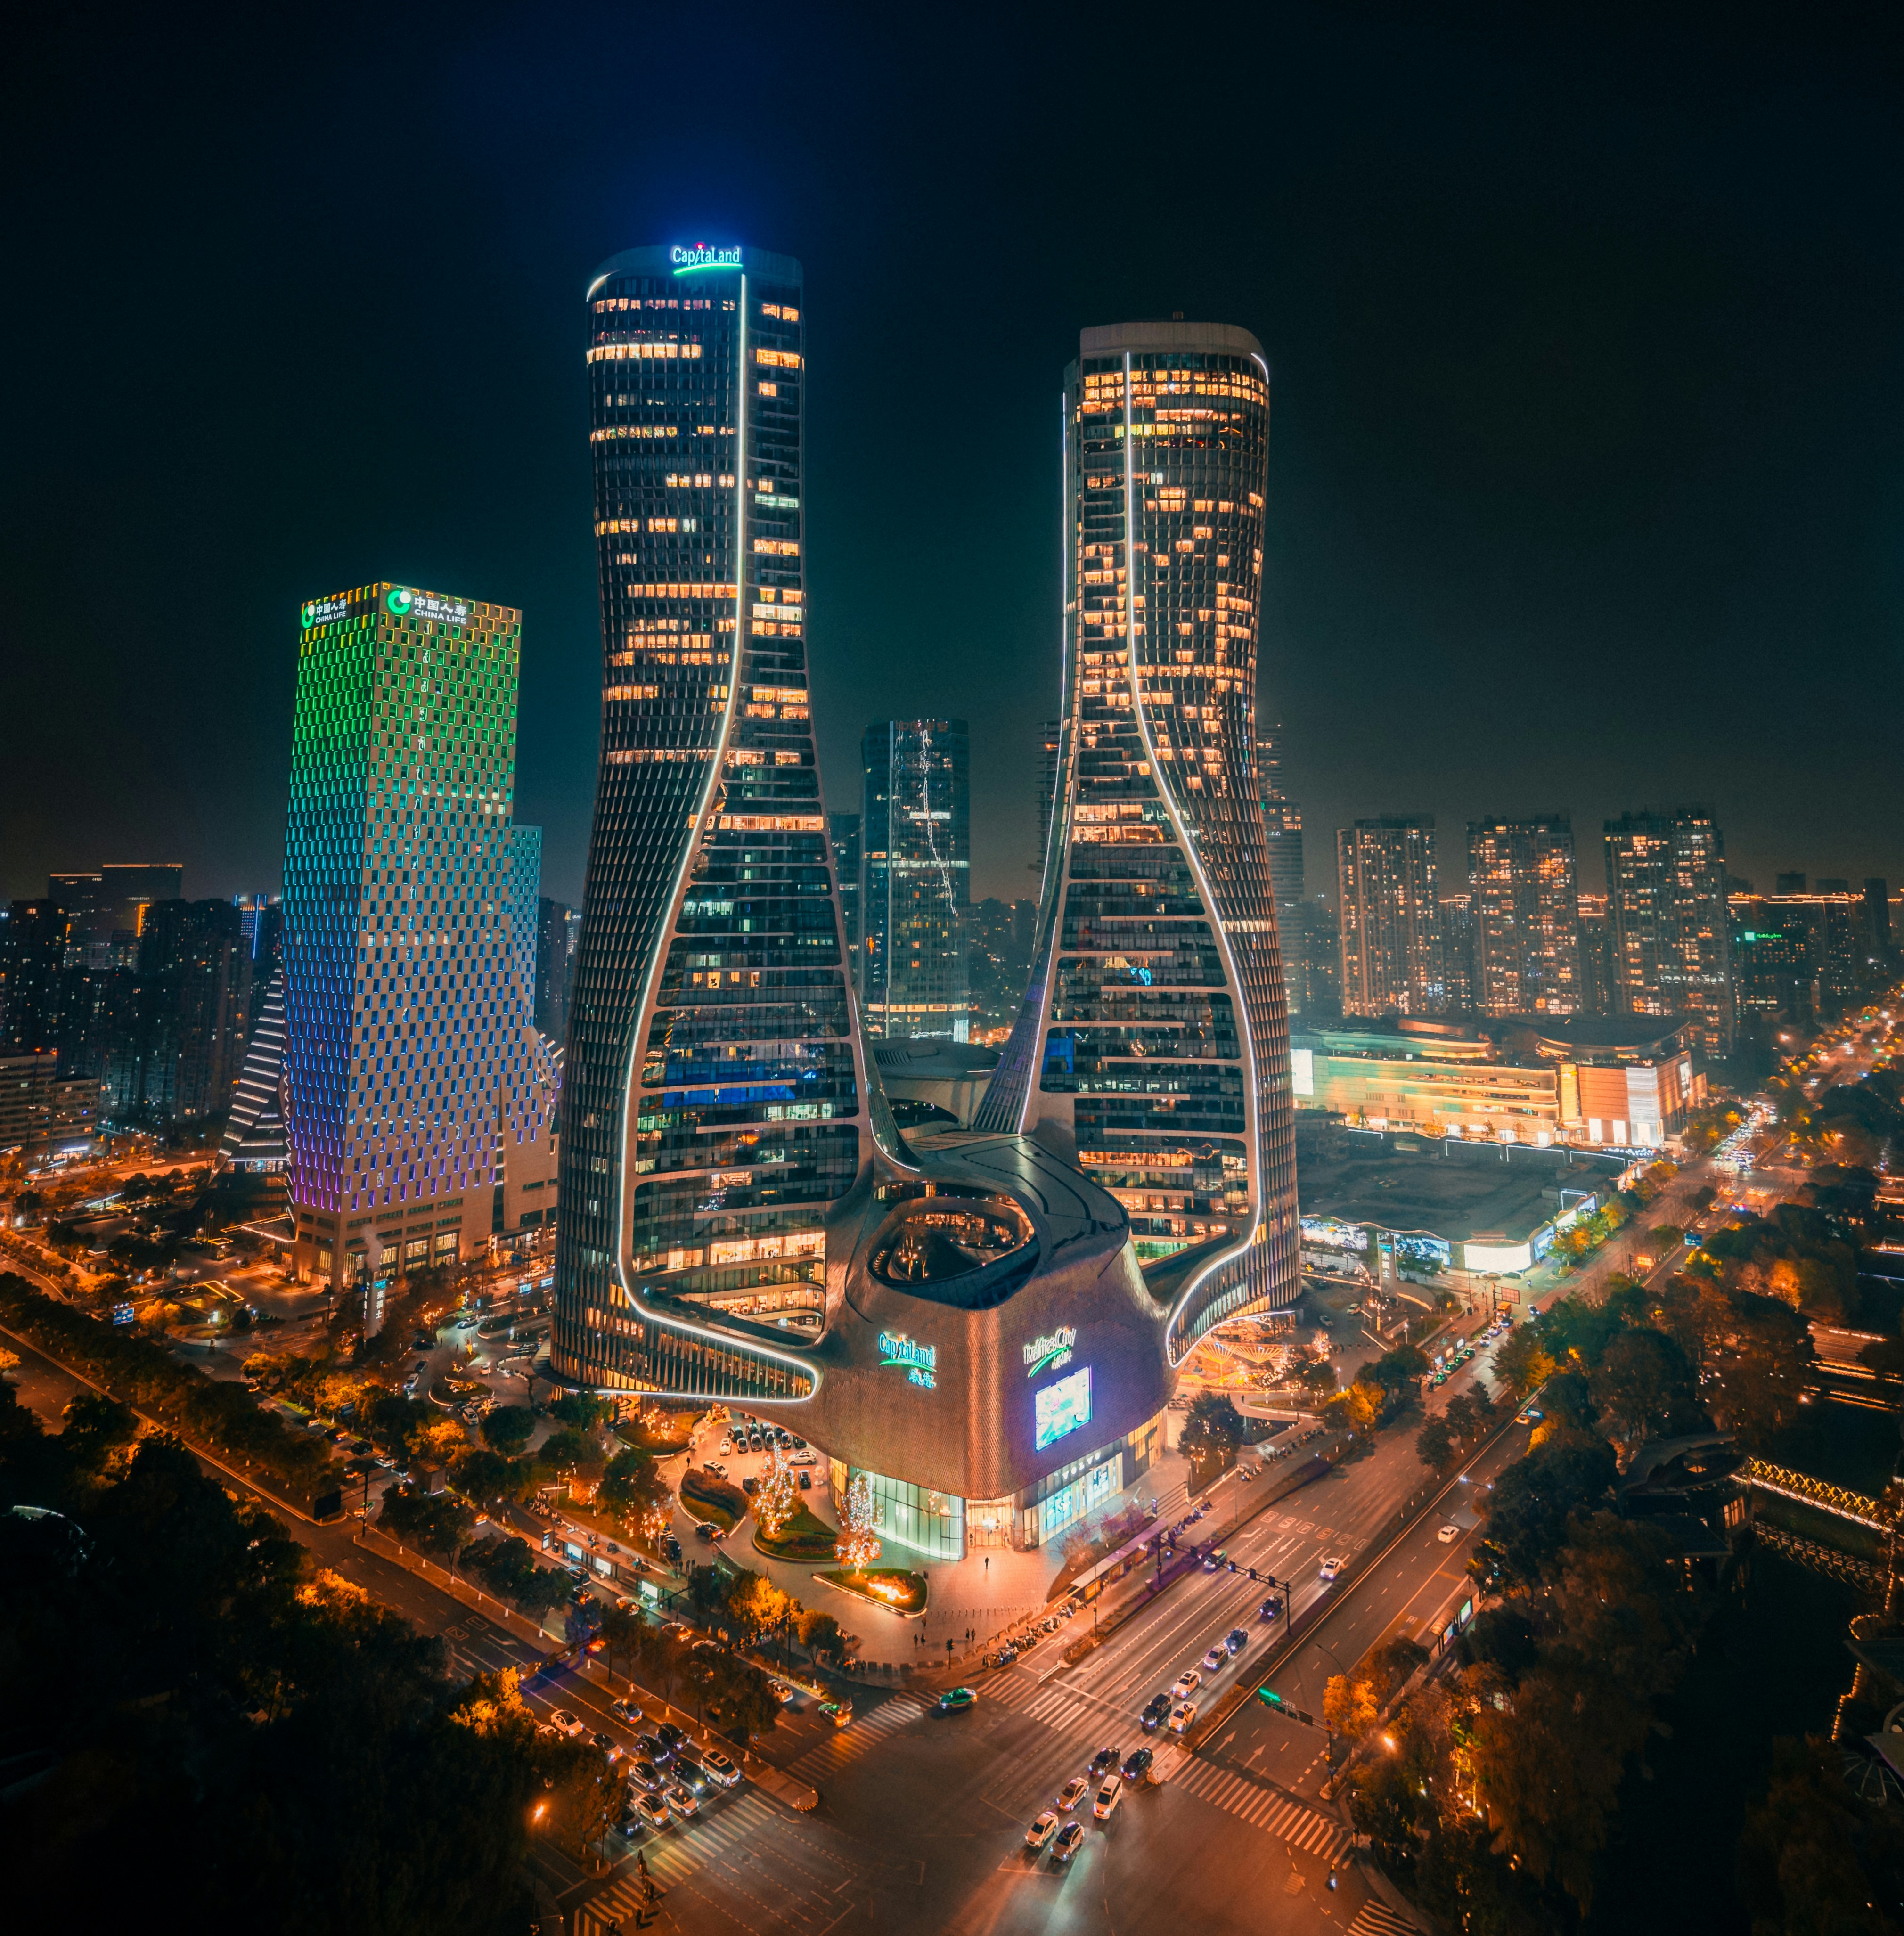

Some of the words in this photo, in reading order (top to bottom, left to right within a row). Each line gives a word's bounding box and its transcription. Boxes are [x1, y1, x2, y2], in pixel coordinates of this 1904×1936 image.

[672, 244, 740, 266] CapitaLand
[316, 599, 346, 616] 中国人寿
[415, 596, 466, 617] 中国人寿
[315, 614, 332, 623] CHINA
[333, 611, 346, 619] LIFE
[415, 609, 444, 620] CHINA
[447, 614, 467, 624] LIFE
[879, 1332, 935, 1367] CapitaLand
